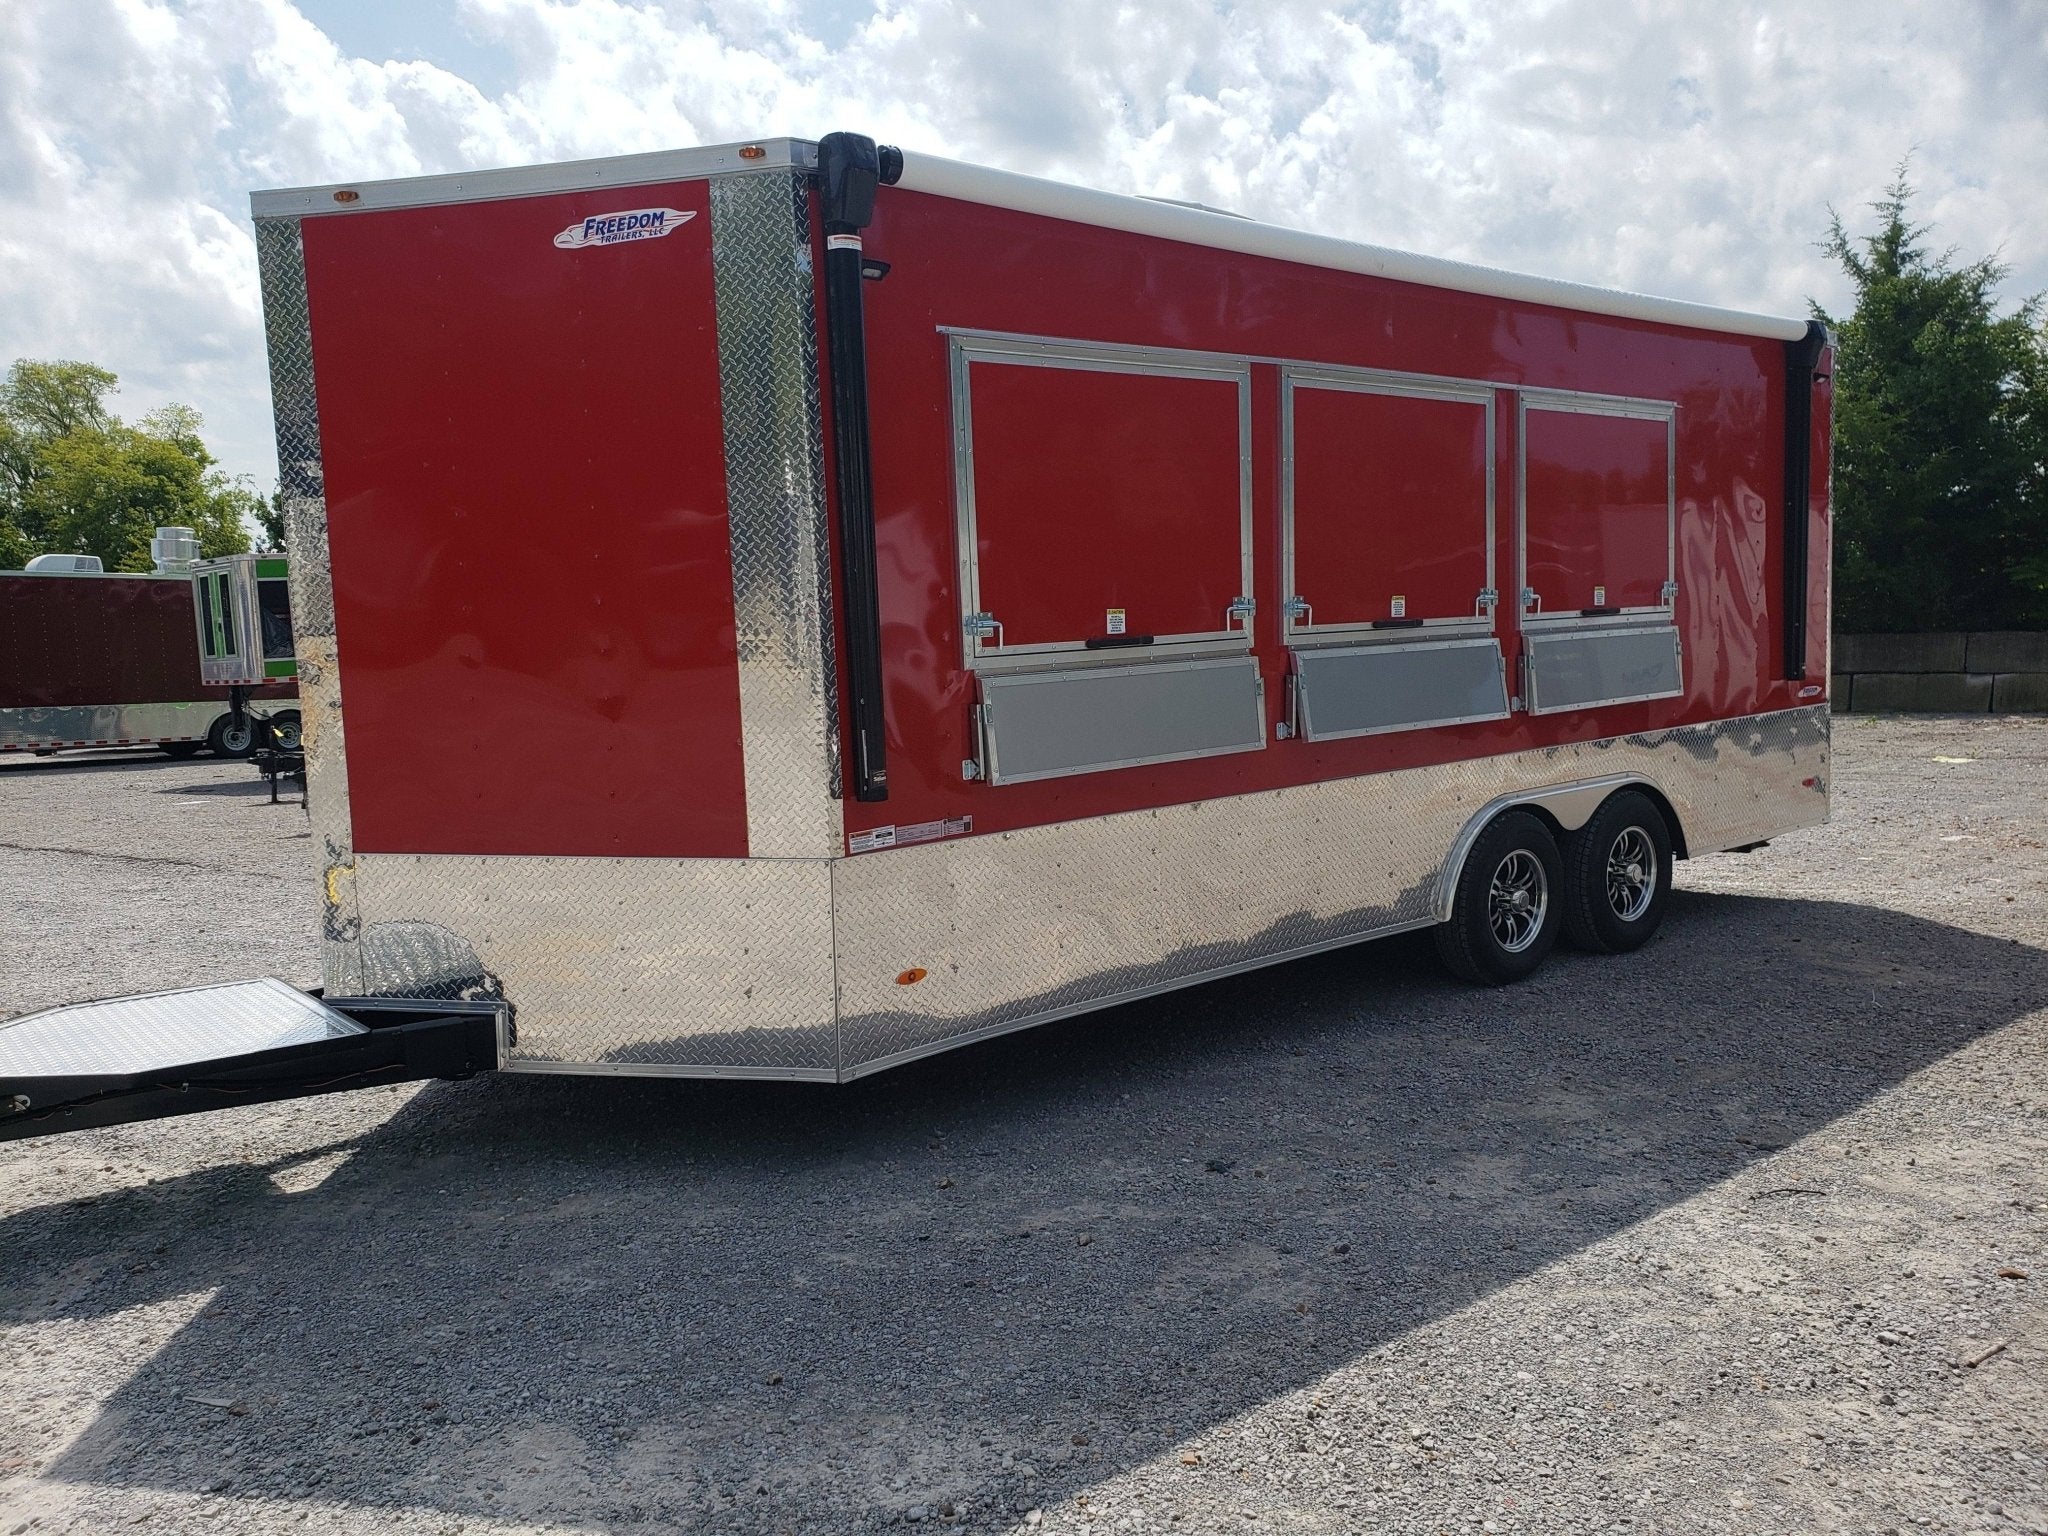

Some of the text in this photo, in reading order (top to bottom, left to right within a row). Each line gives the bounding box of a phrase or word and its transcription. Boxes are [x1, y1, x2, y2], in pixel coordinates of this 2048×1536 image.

[584, 211, 665, 239] FREEDOM
[600, 228, 664, 243] TRAILERS, LLC
